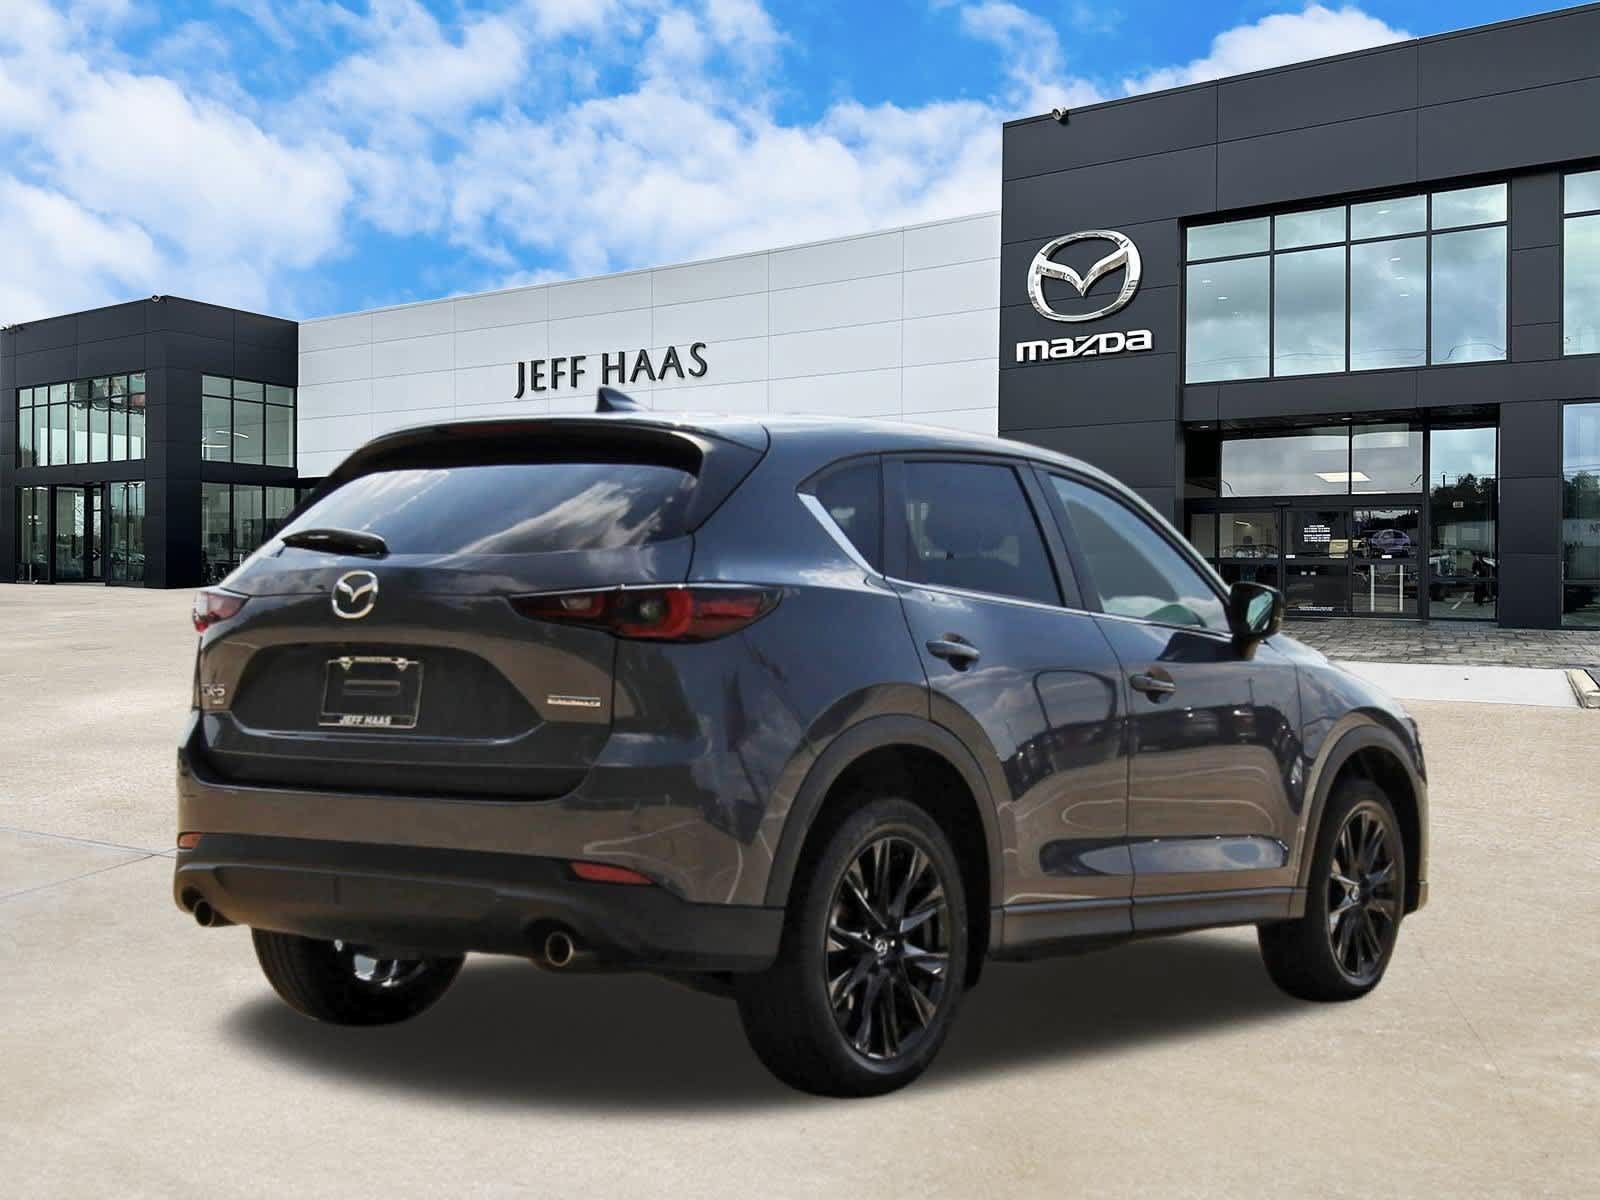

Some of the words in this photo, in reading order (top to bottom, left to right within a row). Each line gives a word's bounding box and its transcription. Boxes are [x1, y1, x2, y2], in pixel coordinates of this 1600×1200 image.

[513, 355, 587, 399] JEFF
[601, 342, 708, 385] HAAS
[340, 714, 364, 726] JEFF
